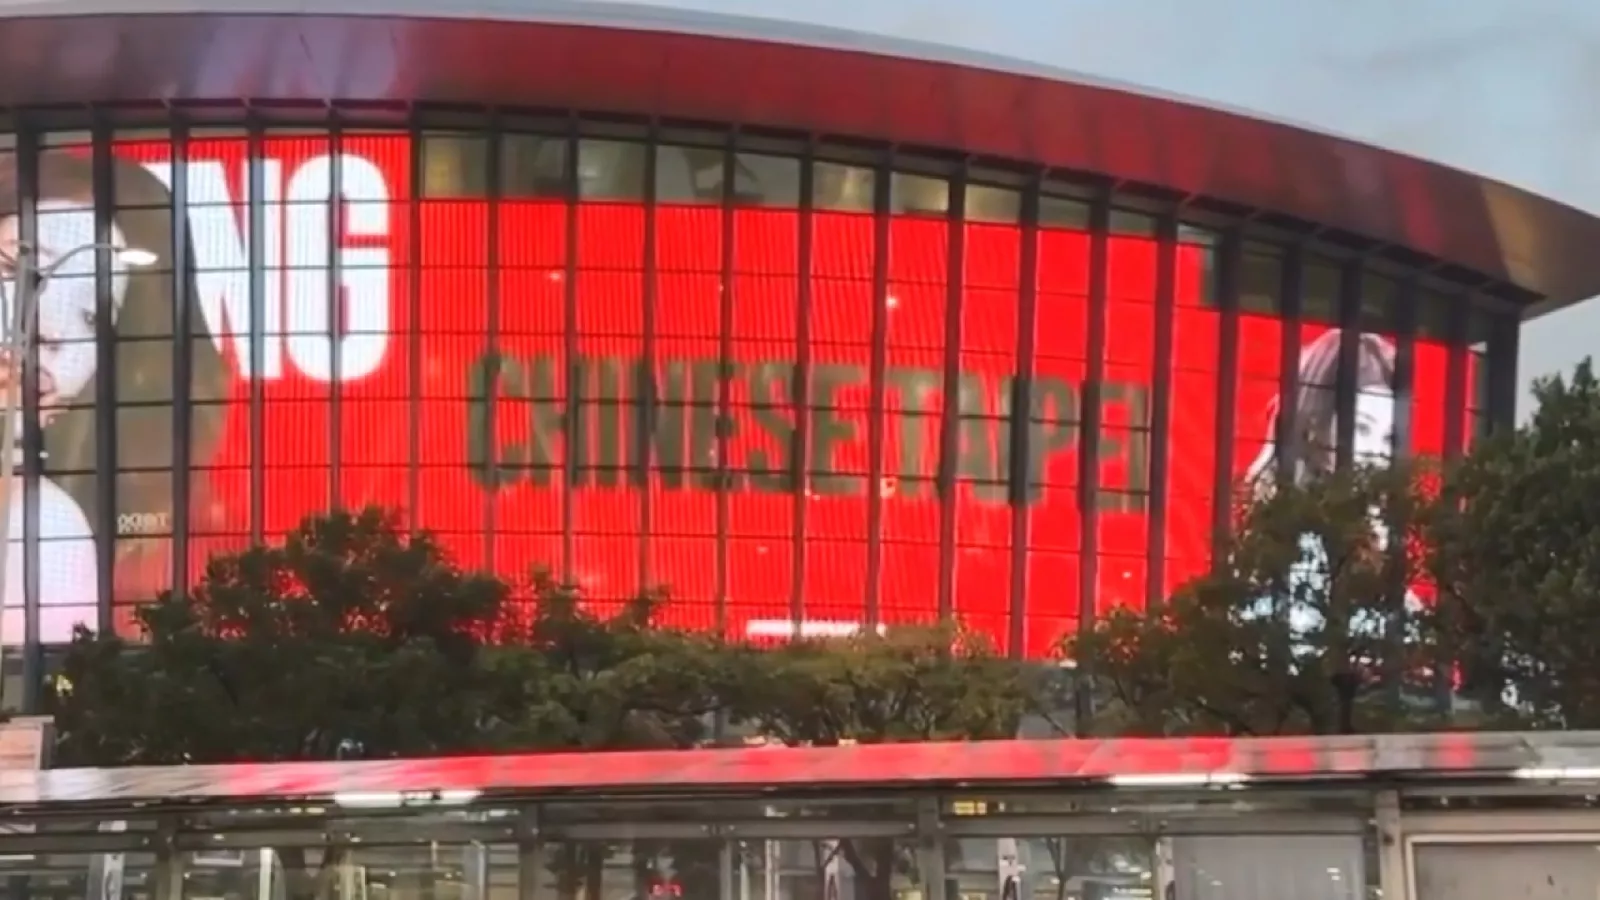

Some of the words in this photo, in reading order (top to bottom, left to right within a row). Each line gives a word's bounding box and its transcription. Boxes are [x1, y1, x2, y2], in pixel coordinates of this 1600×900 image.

[142, 153, 391, 382] NG
[468, 354, 865, 496] CHINESE
[882, 366, 1149, 513] TAIPEI
